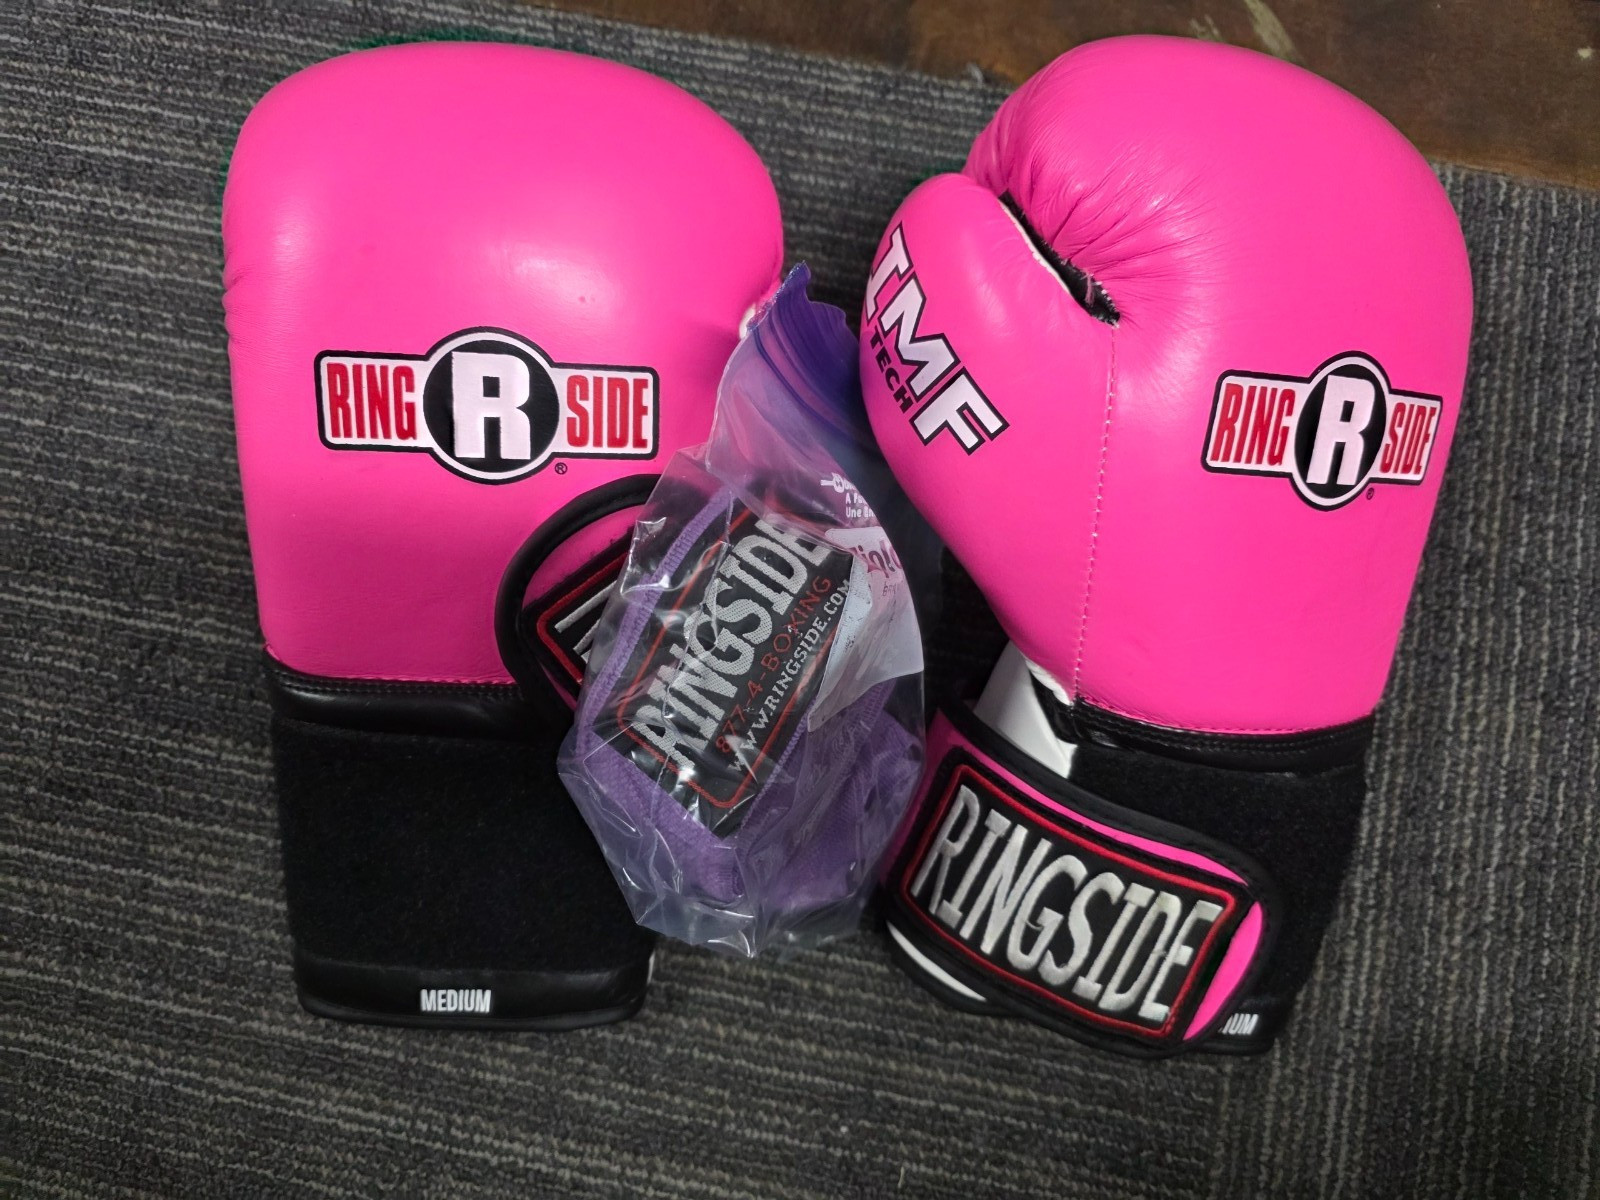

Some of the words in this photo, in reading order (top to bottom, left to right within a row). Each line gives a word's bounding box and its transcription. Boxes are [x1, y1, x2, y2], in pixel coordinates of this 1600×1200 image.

[326, 363, 418, 440] RING
[451, 351, 531, 460] R
[566, 375, 649, 449] SIDE
[865, 221, 1010, 456] IMF
[869, 325, 914, 414] TECH
[1210, 383, 1296, 466] RING
[1306, 374, 1376, 486] R
[1379, 402, 1437, 475] SIDE
[632, 520, 833, 774] RINGSIDE
[716, 576, 831, 753] 877-4-BOXING
[729, 579, 850, 772] WWW.RINGSIDE.COM
[911, 784, 1224, 1022] RINGSIDE
[421, 988, 491, 1013] MEDIUM
[1218, 1012, 1259, 1035] IUM
